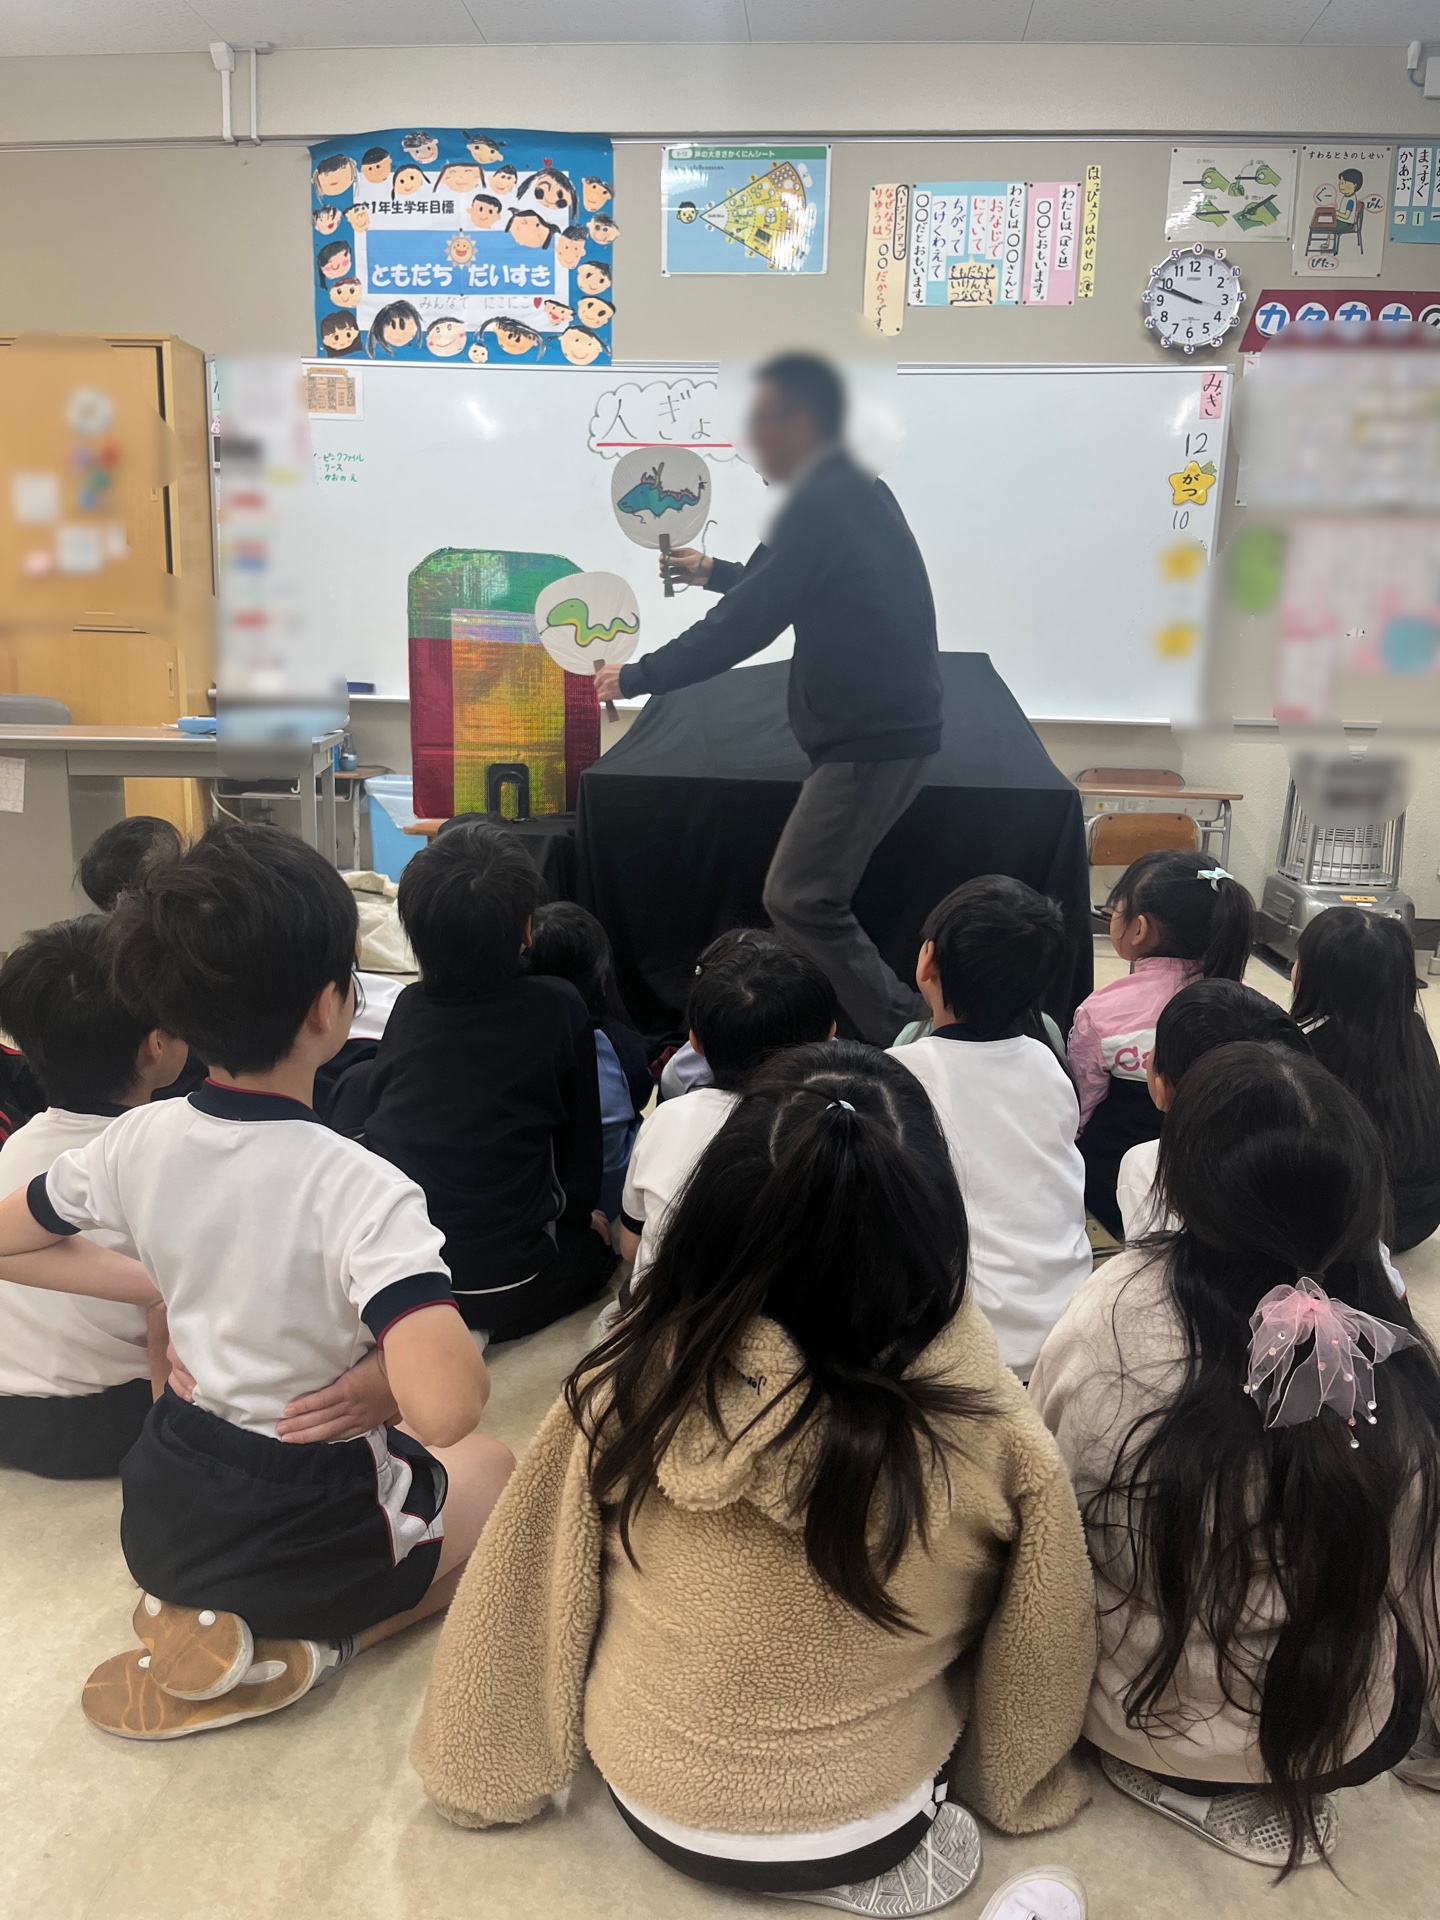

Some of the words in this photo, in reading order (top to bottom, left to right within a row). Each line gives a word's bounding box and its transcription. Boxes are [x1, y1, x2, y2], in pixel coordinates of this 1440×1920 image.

[694, 151, 776, 159] 声の大きさかくにんシート
[1308, 151, 1384, 159] すわるときのしせい
[1397, 151, 1413, 190] かあぶ
[1416, 149, 1429, 198] まっすぐ
[371, 200, 455, 214] 1年生学年目標
[1366, 197, 1383, 209] ぴん
[872, 188, 883, 235] りゆうは
[884, 188, 894, 235] なぜなら
[950, 198, 966, 253] ちがって
[971, 198, 986, 252] にていて
[1082, 167, 1101, 272] はっぴょうはかせの
[988, 199, 1004, 257] おなじで
[931, 200, 947, 279] つけくわえて
[1195, 243, 1202, 253] 0
[1217, 249, 1224, 258] 5
[1171, 250, 1180, 259] 55
[1151, 267, 1161, 277] 50
[1174, 265, 1184, 277] 11
[1190, 261, 1201, 272] 12
[1208, 265, 1213, 277] 1
[1232, 268, 1241, 276] 10
[371, 263, 453, 287] ともだち
[468, 264, 551, 287] だいすき
[1161, 278, 1173, 290] 10
[1217, 277, 1225, 289] 2
[1142, 291, 1152, 301] 45
[1156, 295, 1164, 306] 9
[1221, 294, 1229, 306] 3
[1236, 292, 1244, 302] 15
[484, 296, 530, 309] にこにこ
[1145, 318, 1156, 327] 40
[1160, 311, 1168, 323] 8
[1213, 311, 1222, 322] 4
[1230, 317, 1239, 325] 20
[1172, 323, 1179, 334] 7
[1186, 327, 1194, 338] 6
[1202, 323, 1210, 334] 5
[1203, 373, 1222, 416] みぎ
[1185, 432, 1208, 457] 12
[323, 453, 364, 462] ピンクファイル
[324, 463, 343, 472] リース
[1182, 474, 1200, 497] がつ
[1172, 510, 1190, 530] 10
